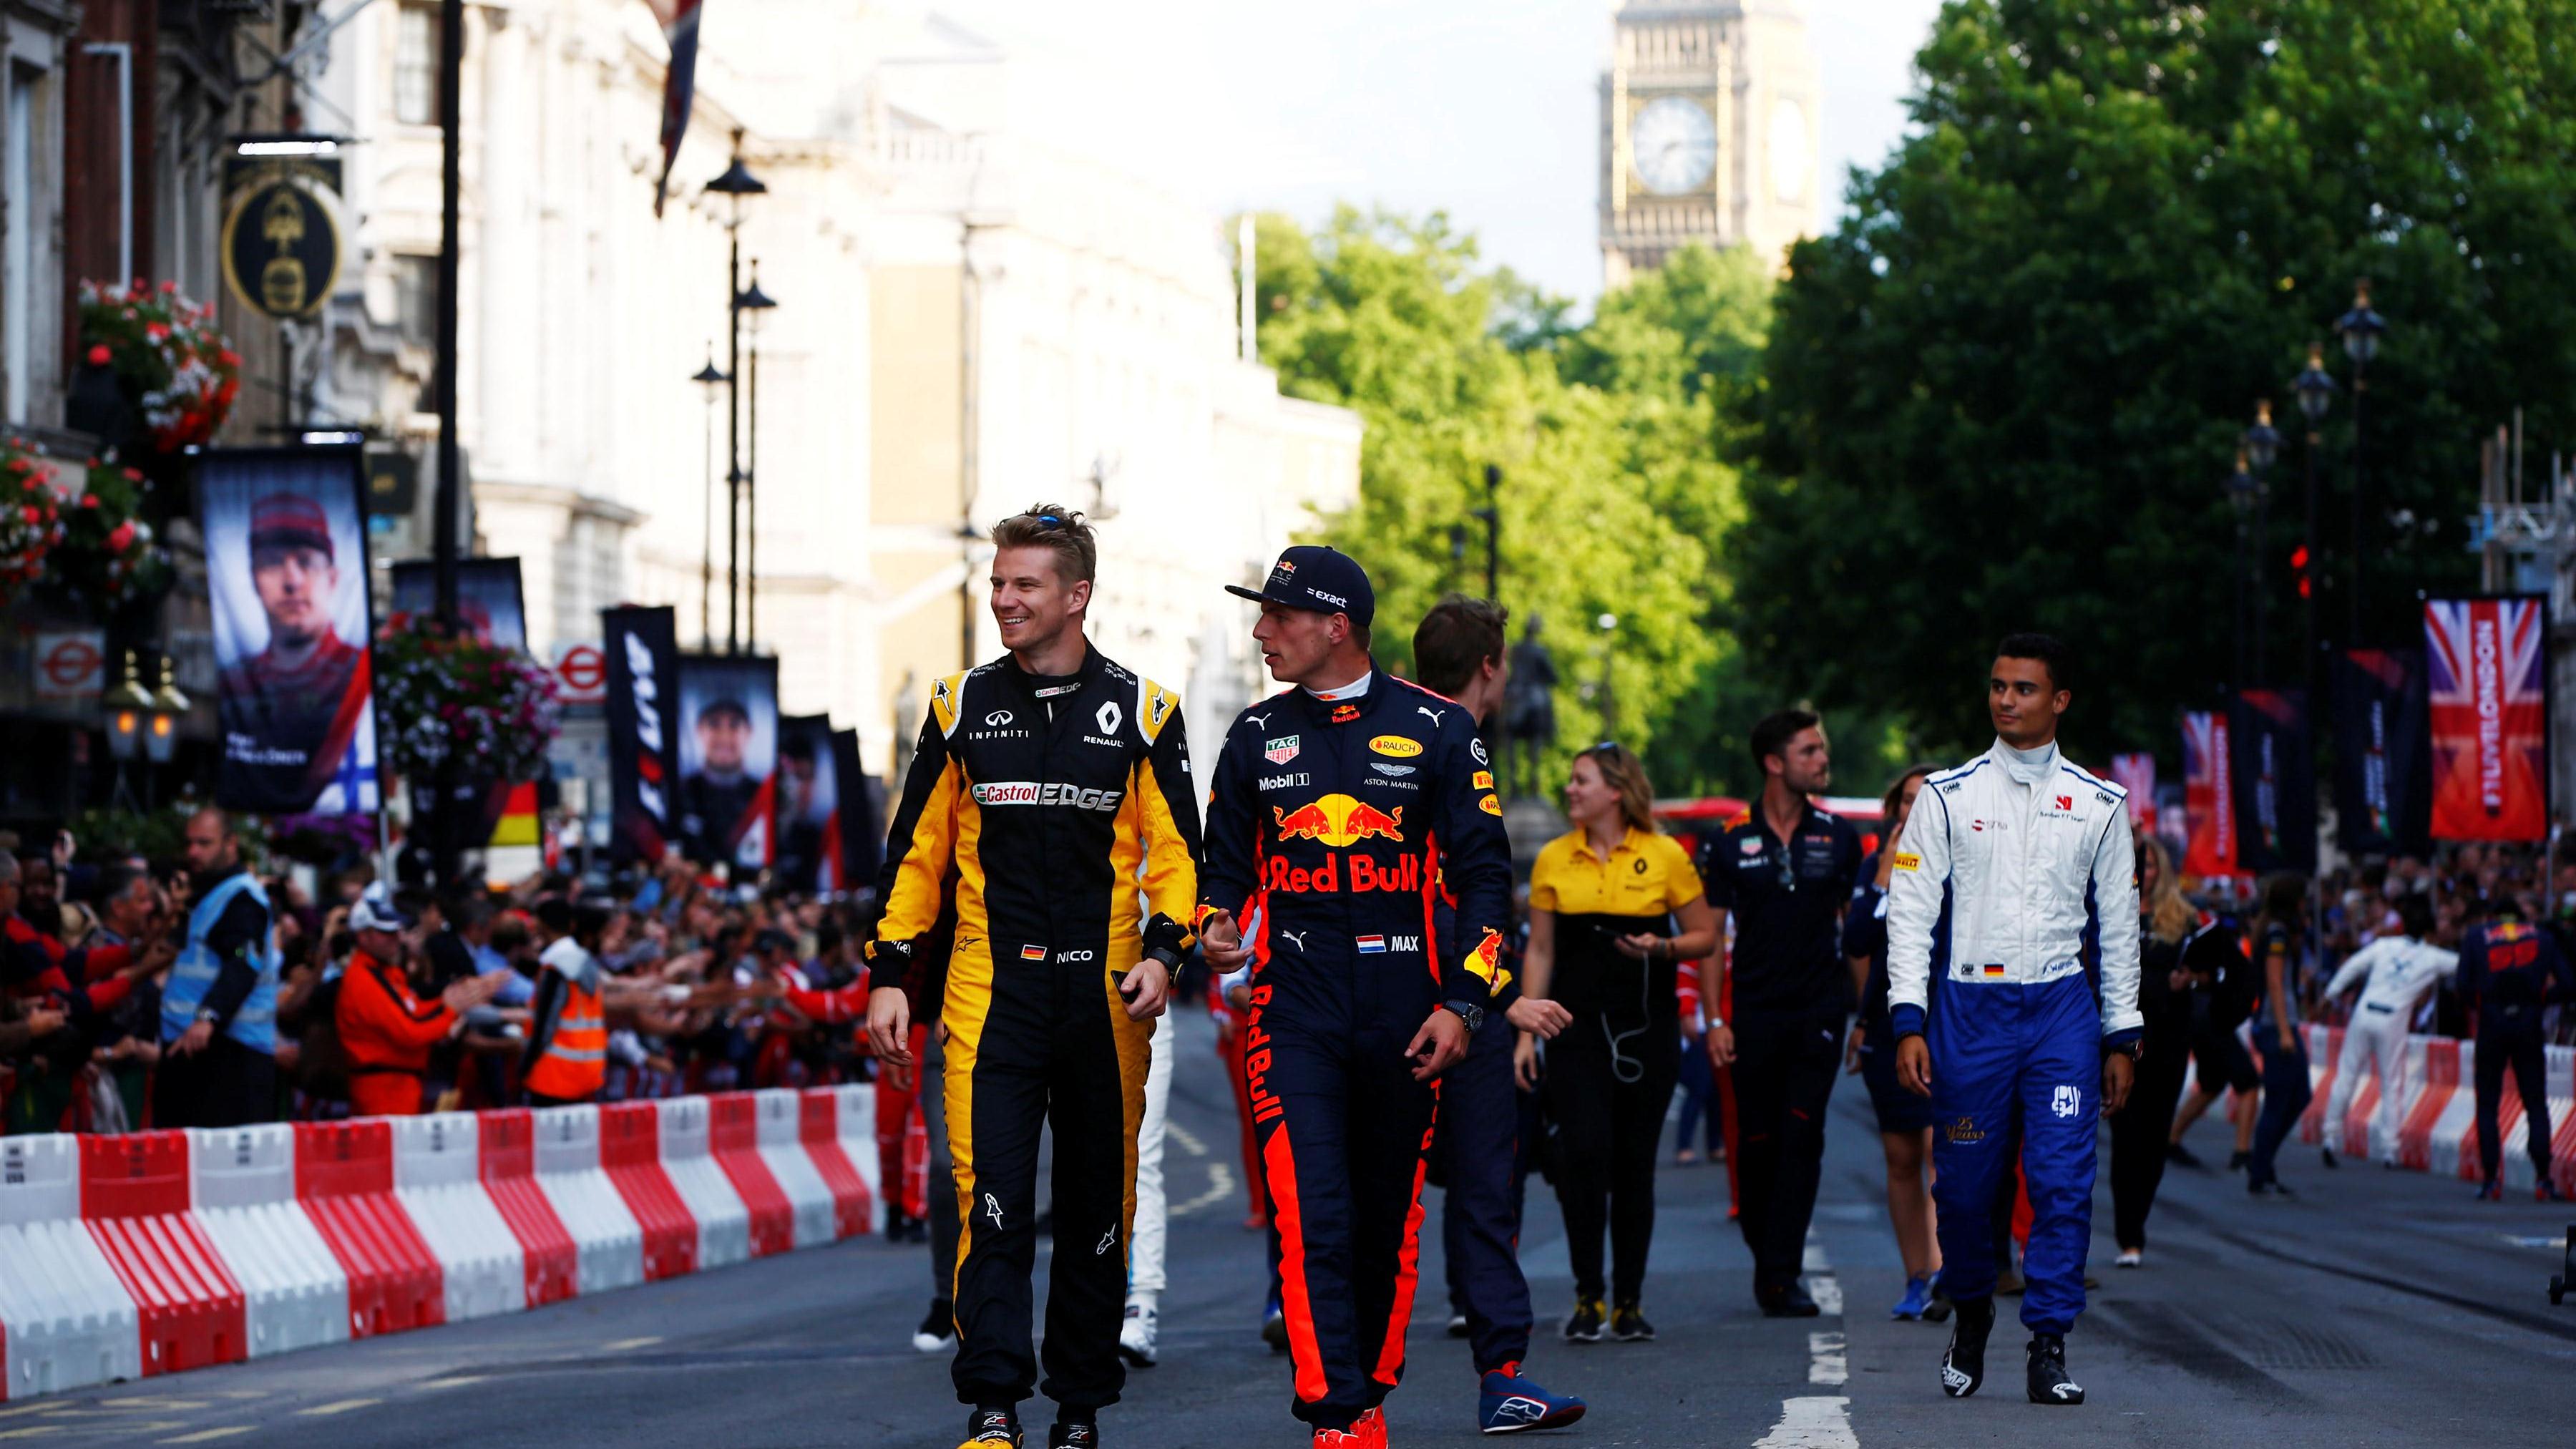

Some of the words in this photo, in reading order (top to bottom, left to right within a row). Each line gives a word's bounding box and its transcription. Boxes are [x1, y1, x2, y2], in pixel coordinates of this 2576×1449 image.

[1059, 682, 1081, 693] EDG
[1332, 715, 1346, 723] Red
[1346, 711, 1360, 721] Bull
[969, 729, 1029, 740] INFINITI
[1269, 737, 1296, 750] TAG
[1382, 741, 1416, 753] RAUCH
[1267, 748, 1297, 763] HEUER
[1258, 774, 1294, 791] Mobil
[1363, 778, 1388, 786] ASTON
[1390, 781, 1419, 791] MARTIN
[987, 785, 1037, 802] Castrol
[1039, 783, 1123, 811] EDGE
[2095, 791, 2115, 806] OMP
[1269, 852, 1339, 894] Red
[1348, 853, 1419, 893] Bull
[1390, 935, 1419, 952] MAX
[1056, 950, 1093, 964] NICO
[1247, 984, 1273, 1051] Red
[1246, 1048, 1284, 1124] Bull
[1957, 1116, 1974, 1131] 25
